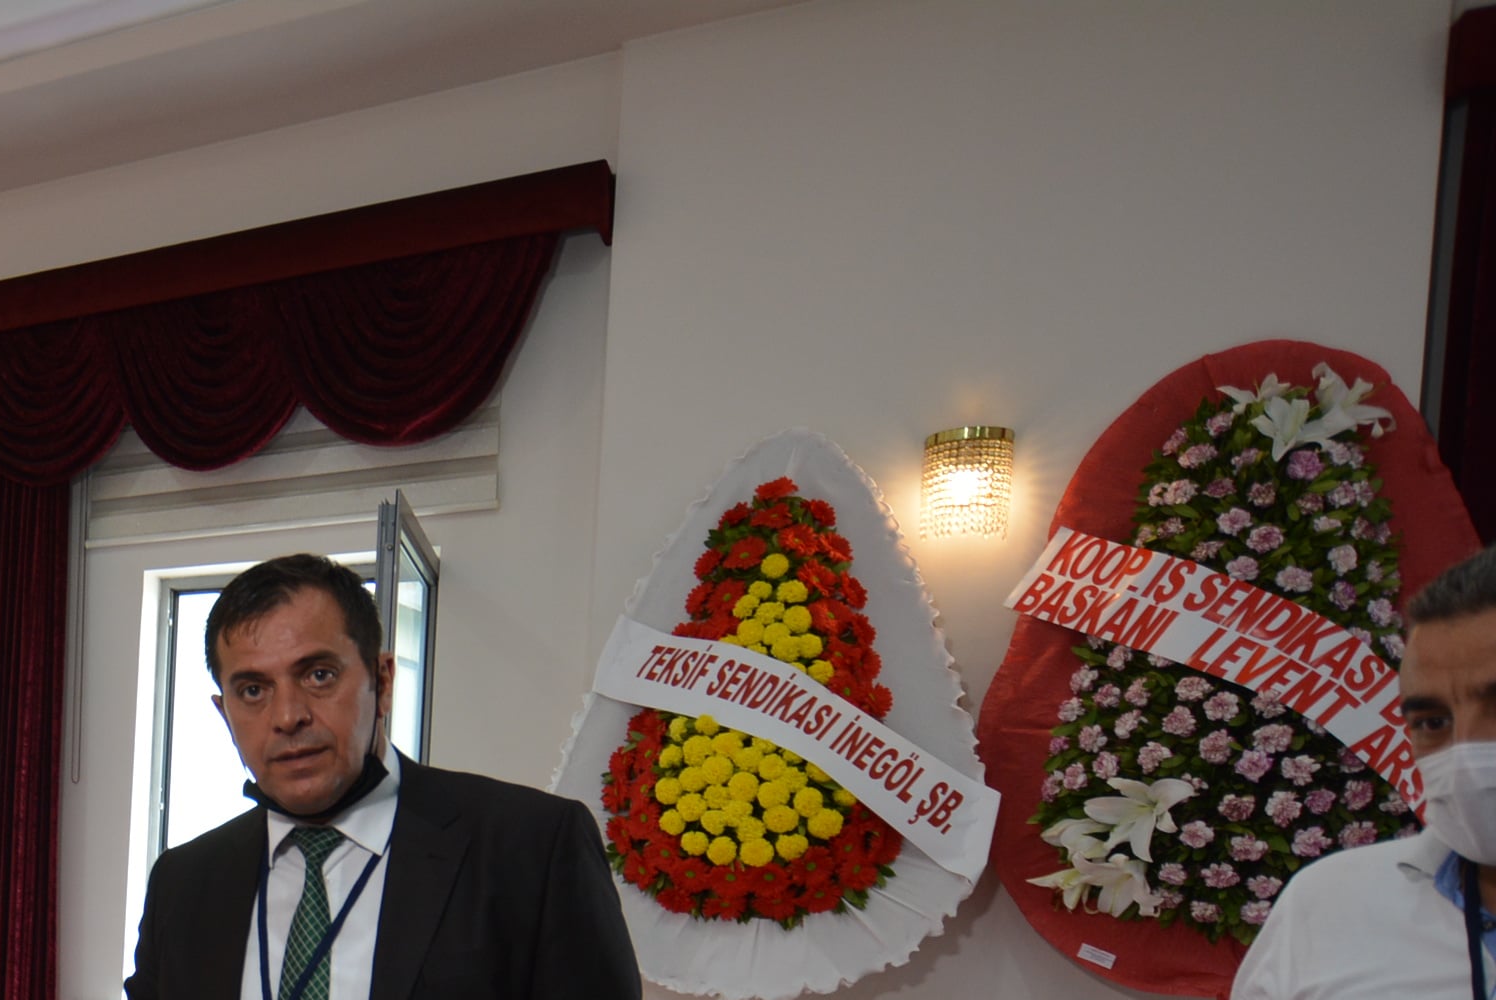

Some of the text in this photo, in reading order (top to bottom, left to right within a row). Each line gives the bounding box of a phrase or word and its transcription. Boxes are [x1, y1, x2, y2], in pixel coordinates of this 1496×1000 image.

[636, 644, 715, 690] TEKSİF
[707, 659, 843, 741] SENDİKASI
[829, 715, 925, 799] İNEGÖL
[1185, 627, 1361, 727] LEVENT
